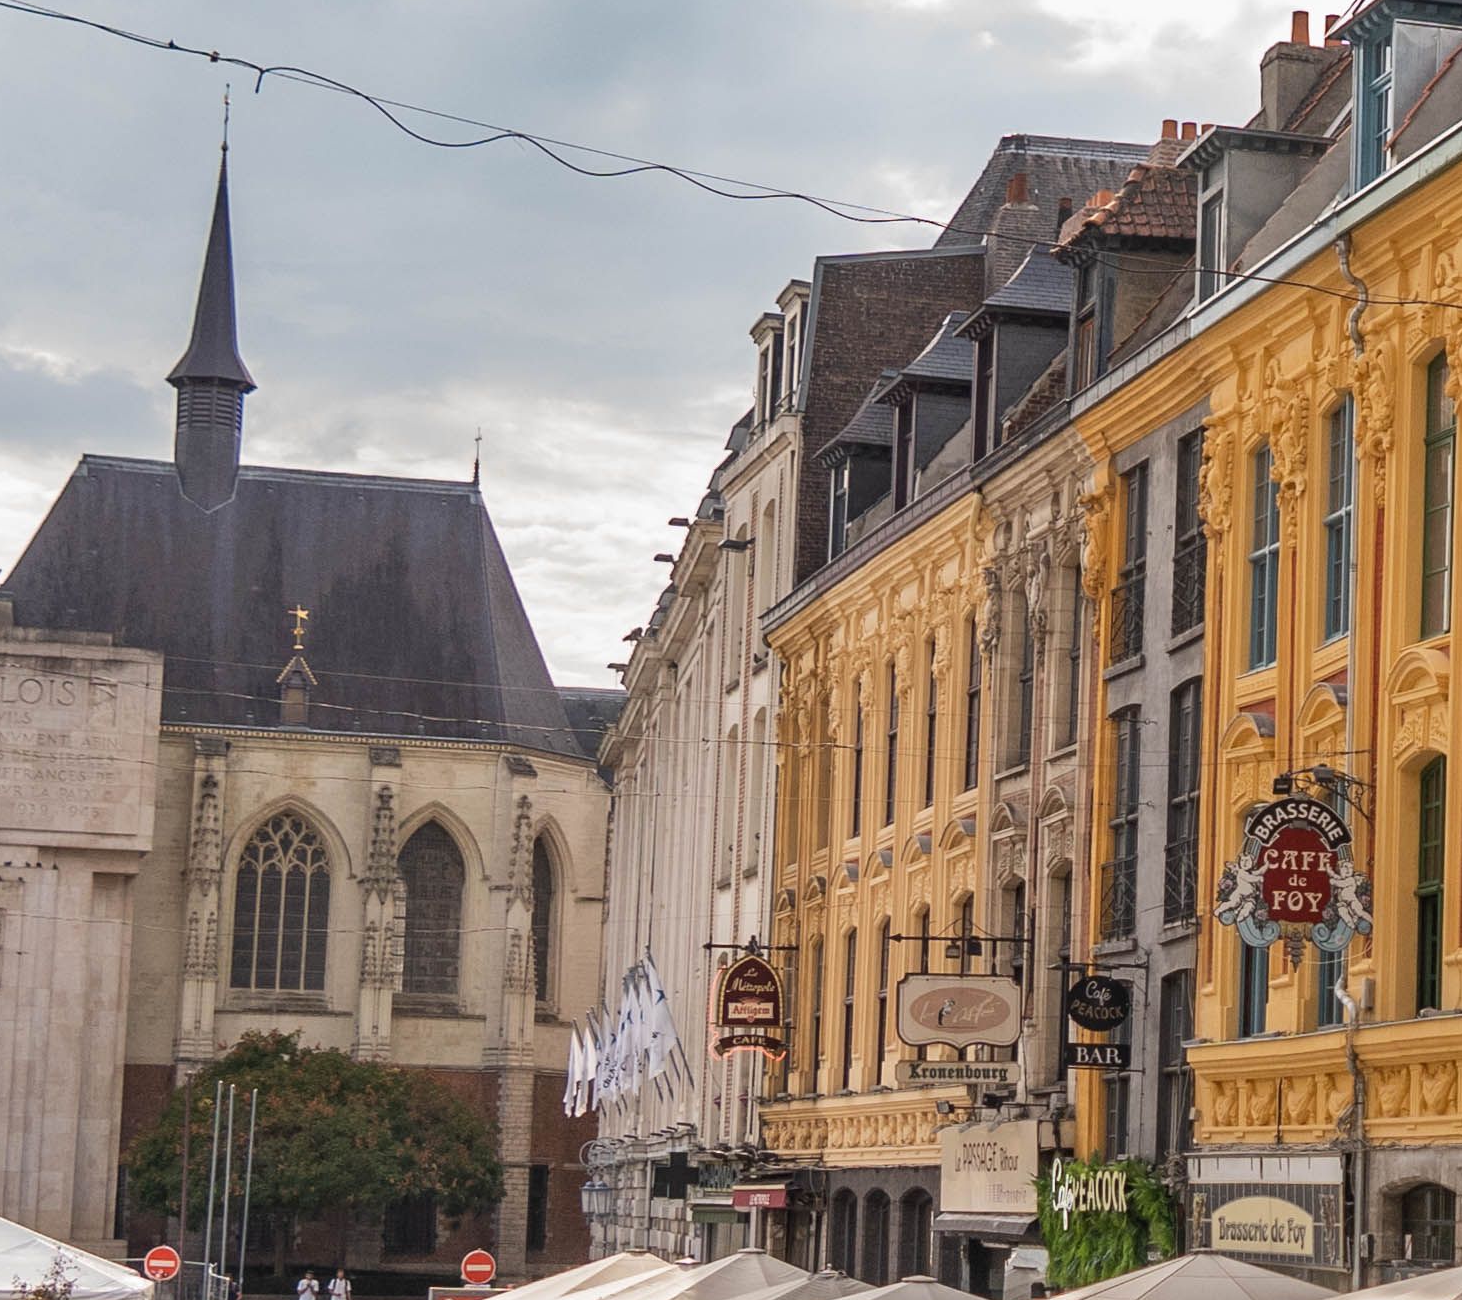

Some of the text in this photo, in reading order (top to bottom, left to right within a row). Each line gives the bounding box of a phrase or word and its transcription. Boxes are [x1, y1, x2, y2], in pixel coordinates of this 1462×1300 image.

[1254, 803, 1344, 842] BRASSERIE
[1287, 873, 1307, 887] de
[1271, 890, 1324, 913] FOY
[1085, 980, 1112, 1006] Café
[1070, 1000, 1125, 1020] PEACOCK
[1076, 1046, 1122, 1064] BAR
[908, 1063, 1009, 1082] Kronenbourg
[963, 1142, 998, 1174] PASSAGE
[1051, 1157, 1128, 1231] Café PEACOCK
[1218, 1216, 1307, 1250] Brasserie de Foy
